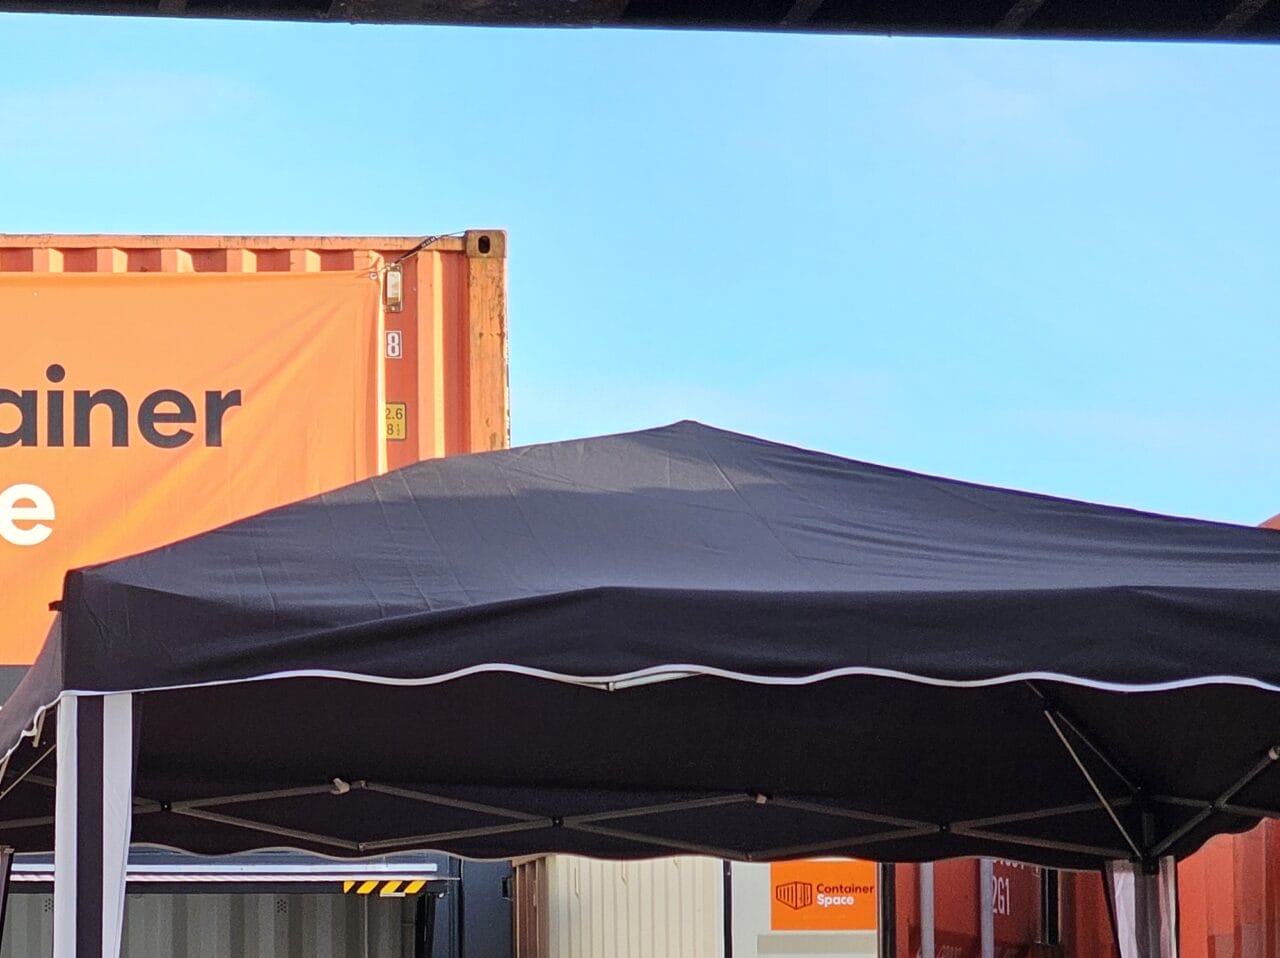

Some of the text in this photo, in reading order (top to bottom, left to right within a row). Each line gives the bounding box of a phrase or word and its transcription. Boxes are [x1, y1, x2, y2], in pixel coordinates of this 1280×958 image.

[386, 332, 400, 357] 8
[816, 883, 875, 895] Container
[816, 894, 855, 908] Space
